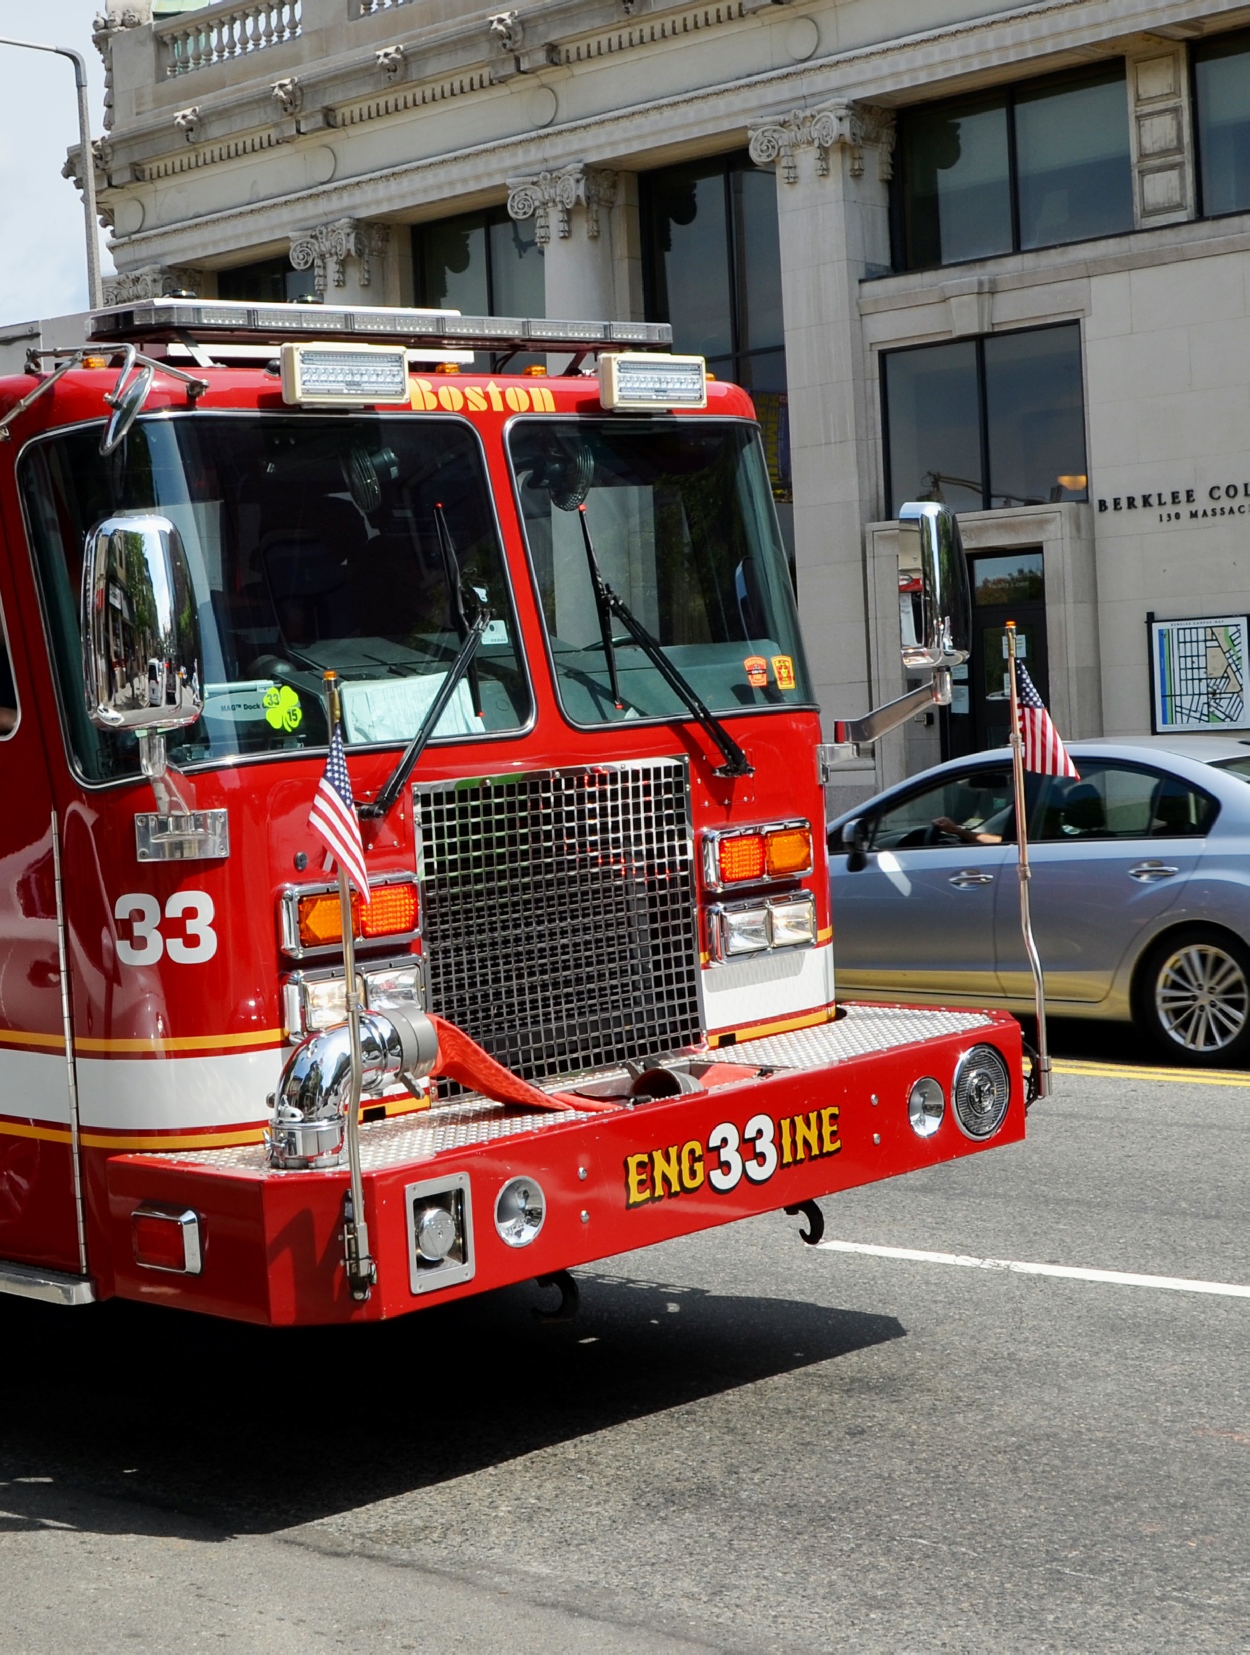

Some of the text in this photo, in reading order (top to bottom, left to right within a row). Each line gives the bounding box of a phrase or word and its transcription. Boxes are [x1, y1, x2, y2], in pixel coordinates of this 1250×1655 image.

[408, 378, 556, 413] Boston
[1098, 482, 1250, 513] BERKLEE COL
[1158, 504, 1250, 523] 130 MASSAC
[266, 693, 280, 706] 33
[287, 708, 298, 722] 15
[114, 890, 218, 966] 33
